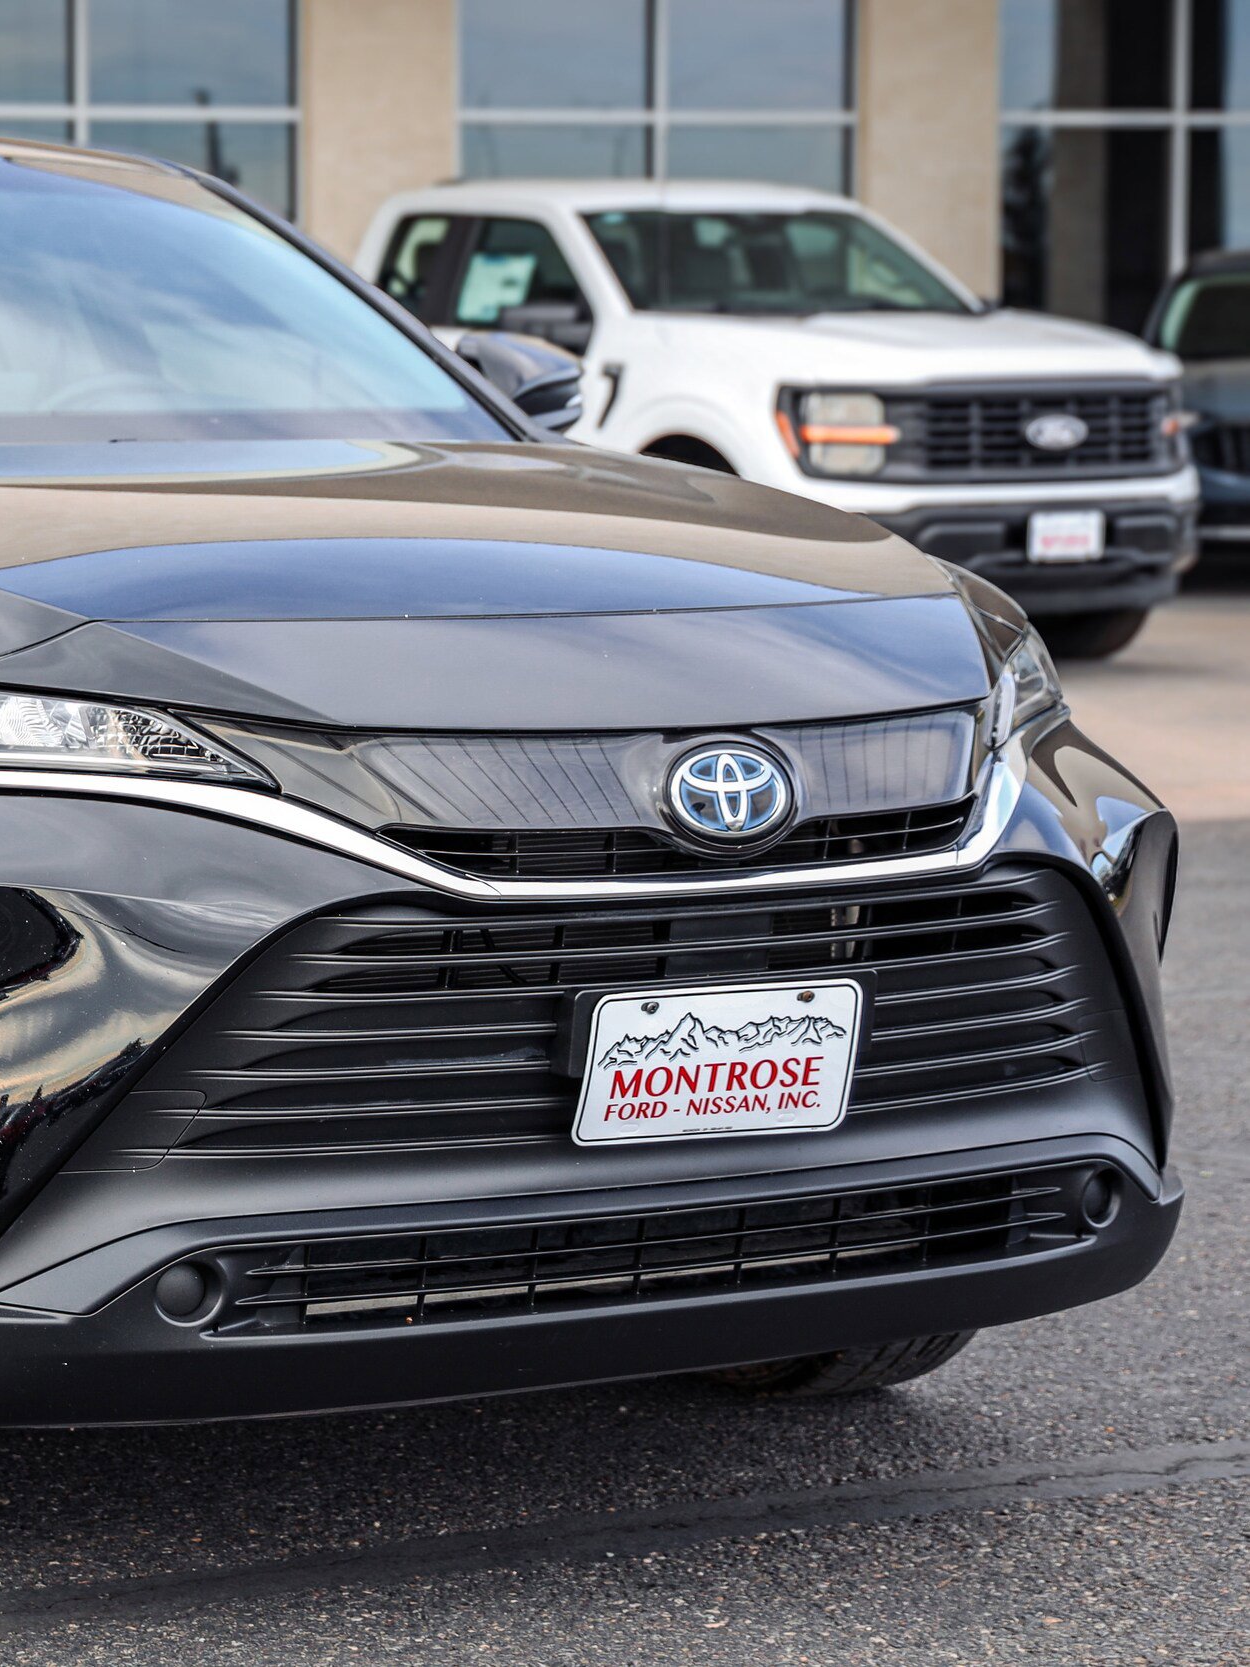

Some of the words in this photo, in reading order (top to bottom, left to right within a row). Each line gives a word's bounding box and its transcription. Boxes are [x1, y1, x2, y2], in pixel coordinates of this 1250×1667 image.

[609, 1056, 824, 1100] MONTROSE
[603, 1101, 668, 1122] FORD
[686, 1093, 771, 1116] NISSAN,
[777, 1090, 821, 1110] INC.
